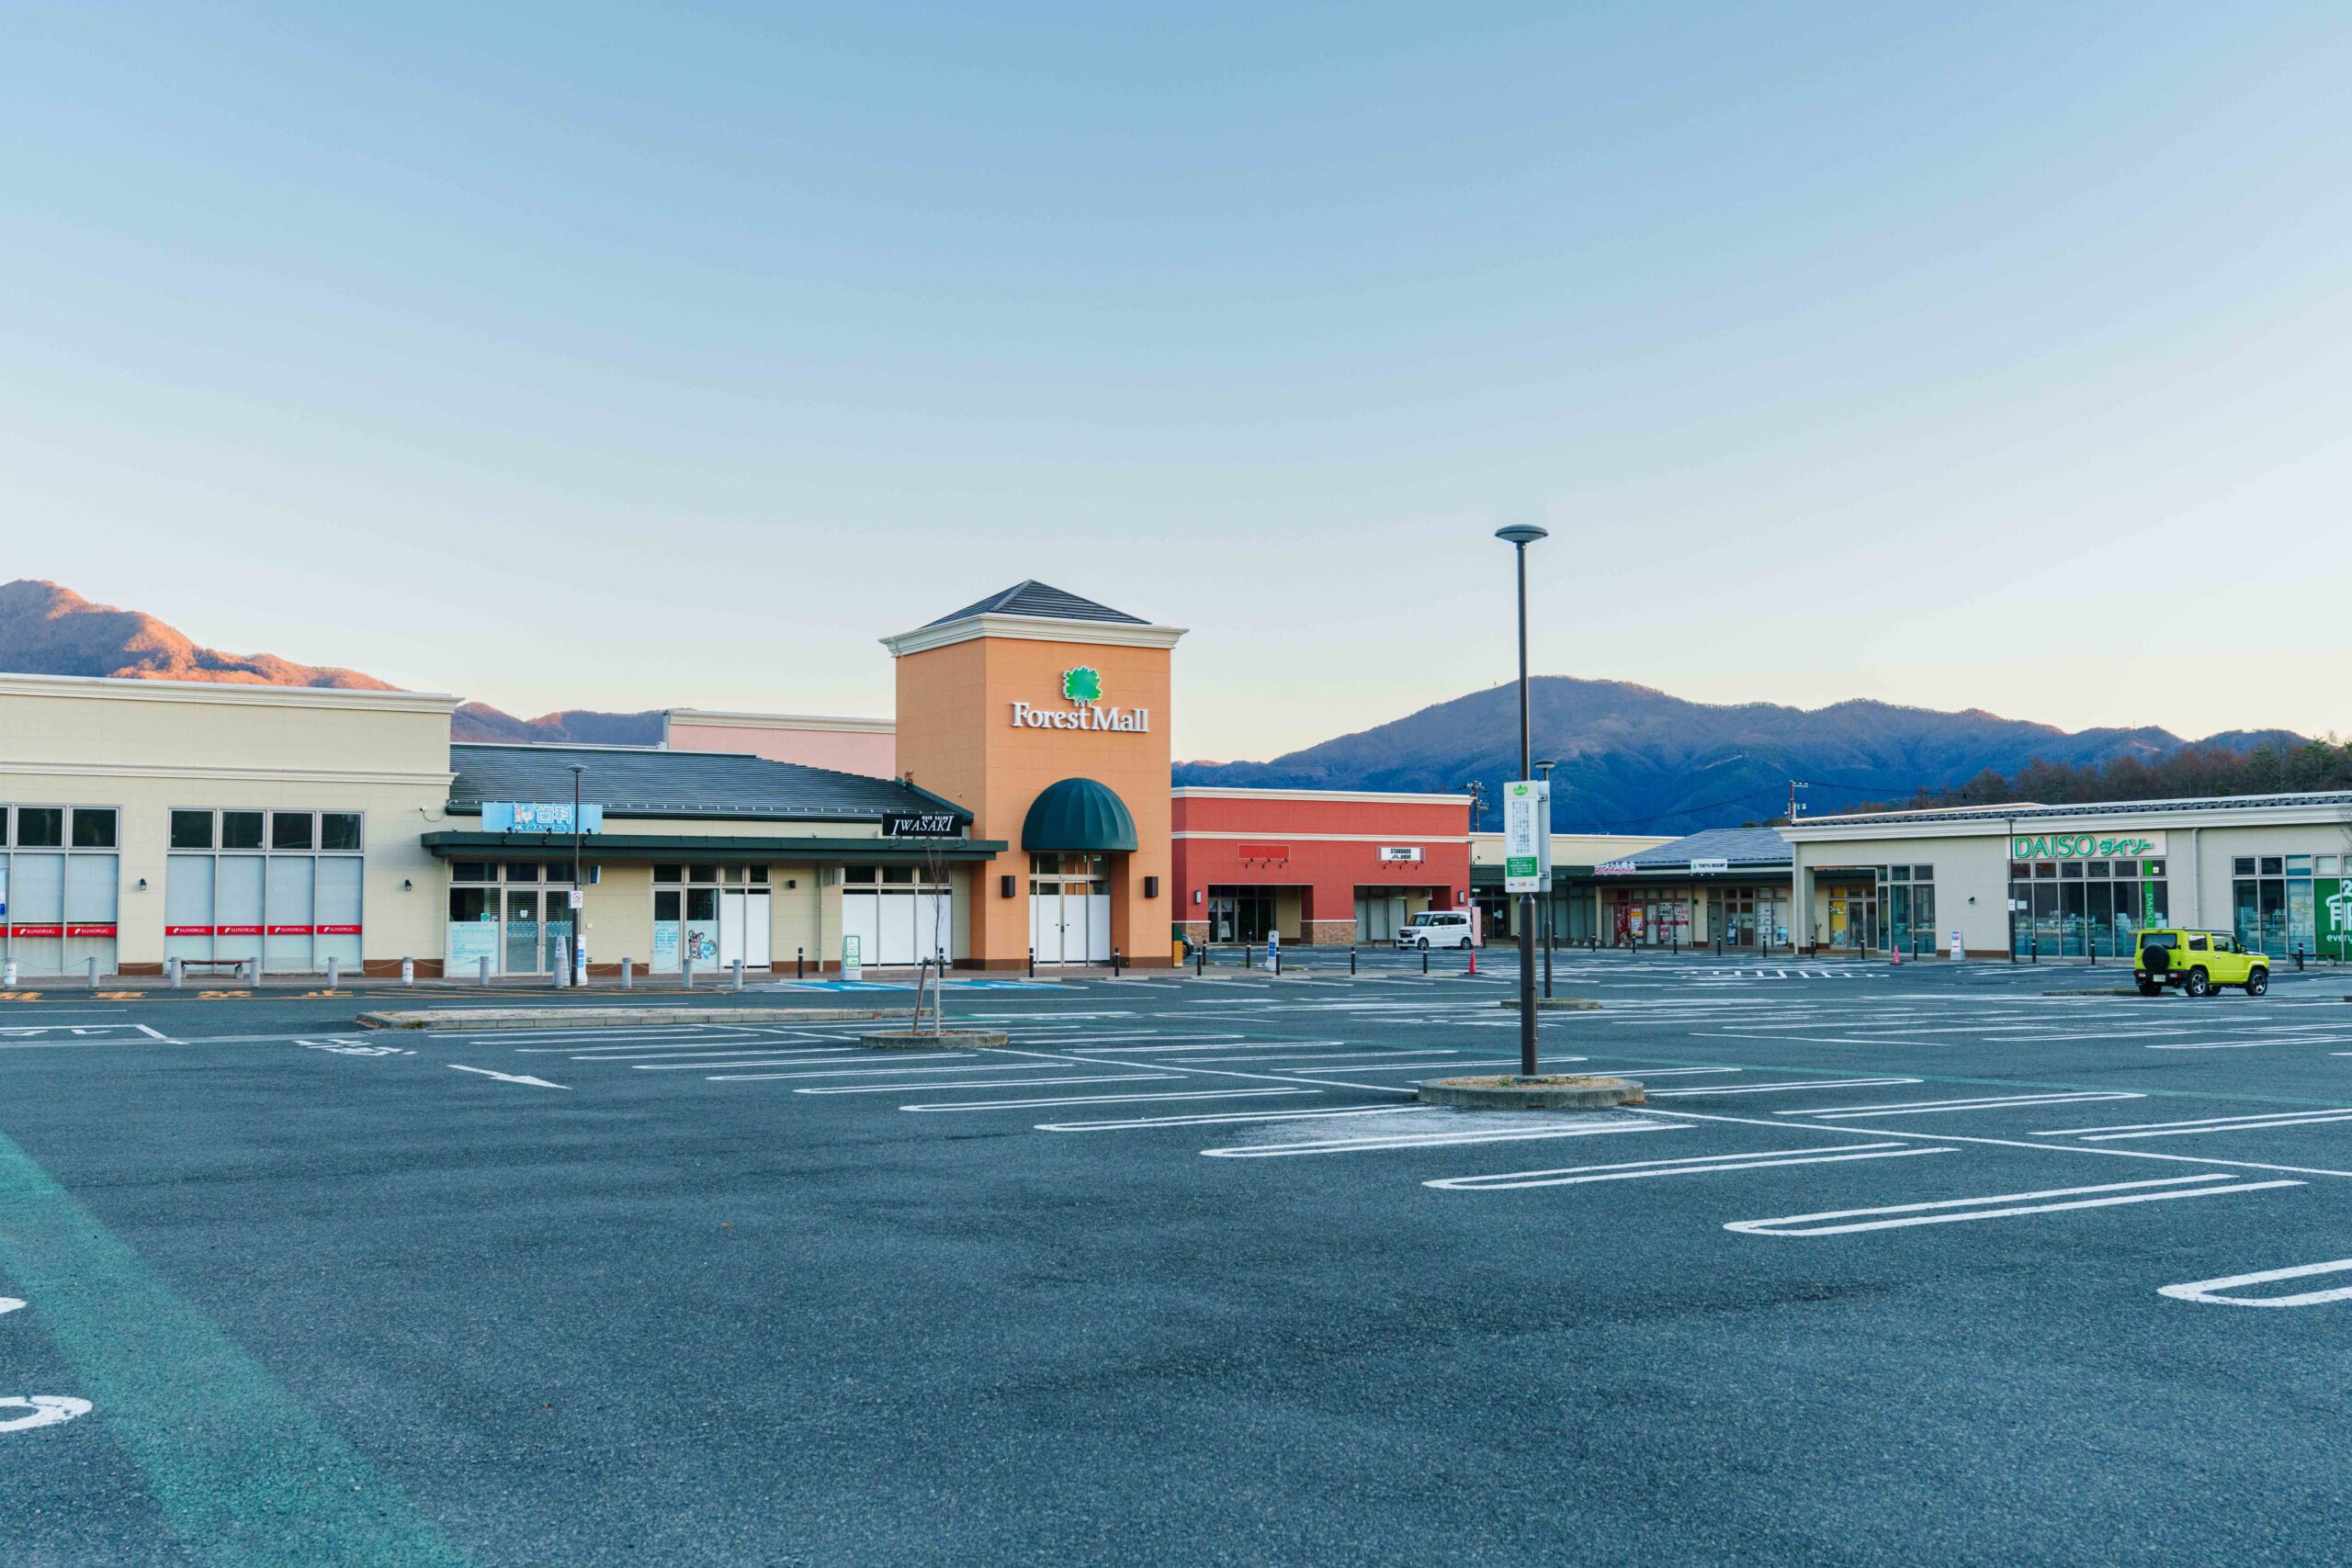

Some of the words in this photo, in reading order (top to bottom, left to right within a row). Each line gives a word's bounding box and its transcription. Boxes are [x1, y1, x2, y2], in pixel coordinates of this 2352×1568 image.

[1012, 702, 1091, 730] Forest
[1091, 706, 1150, 732] Mall
[537, 806, 573, 824] 歯科
[890, 816, 955, 836] IWASAKI
[2015, 835, 2095, 857] DAISO
[2099, 838, 2153, 856] ダイソー
[2146, 893, 2154, 923] DAISO
